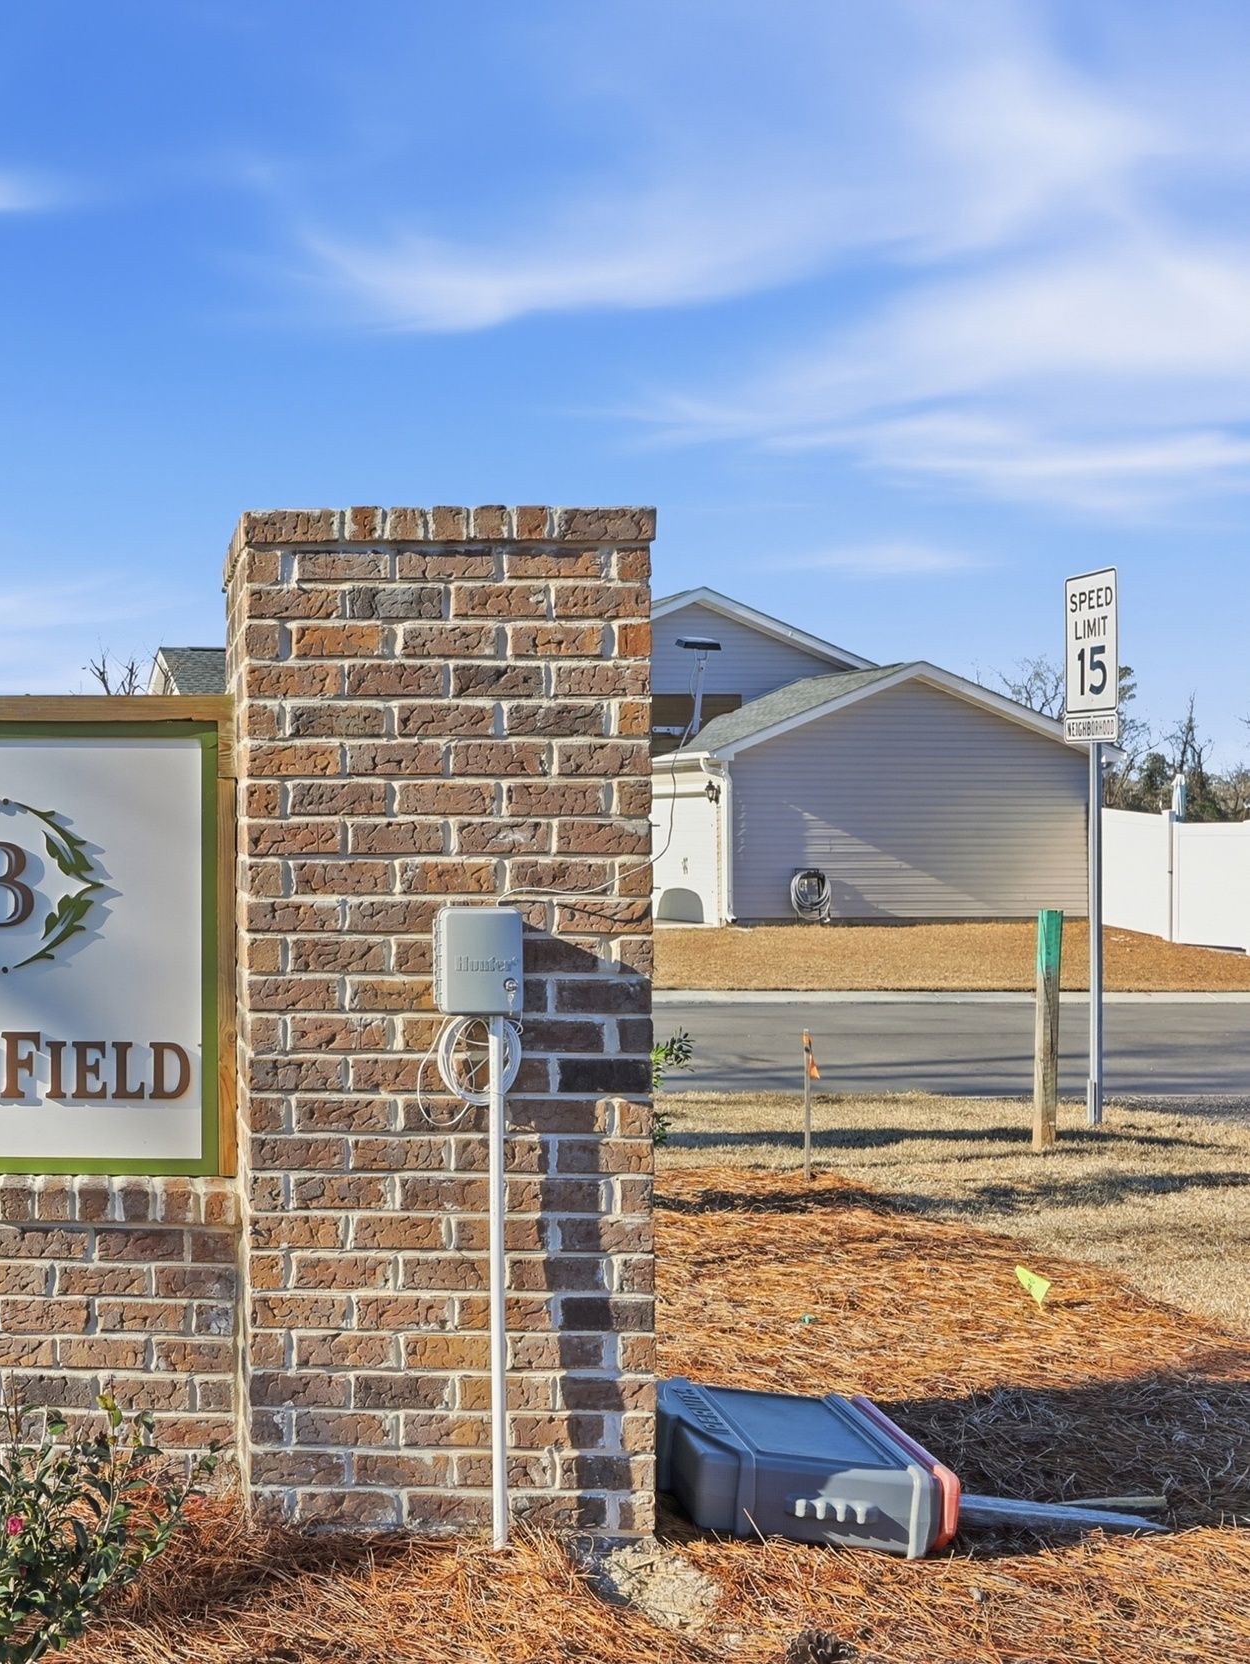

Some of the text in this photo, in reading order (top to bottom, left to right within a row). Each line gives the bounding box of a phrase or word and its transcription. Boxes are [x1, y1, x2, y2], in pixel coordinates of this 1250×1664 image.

[1070, 586, 1113, 613] SPEED
[1075, 615, 1108, 640] LIMIT
[1077, 645, 1107, 696] 15
[1067, 720, 1114, 736] NEIGHBORHOOD
[455, 955, 517, 972] Hunter
